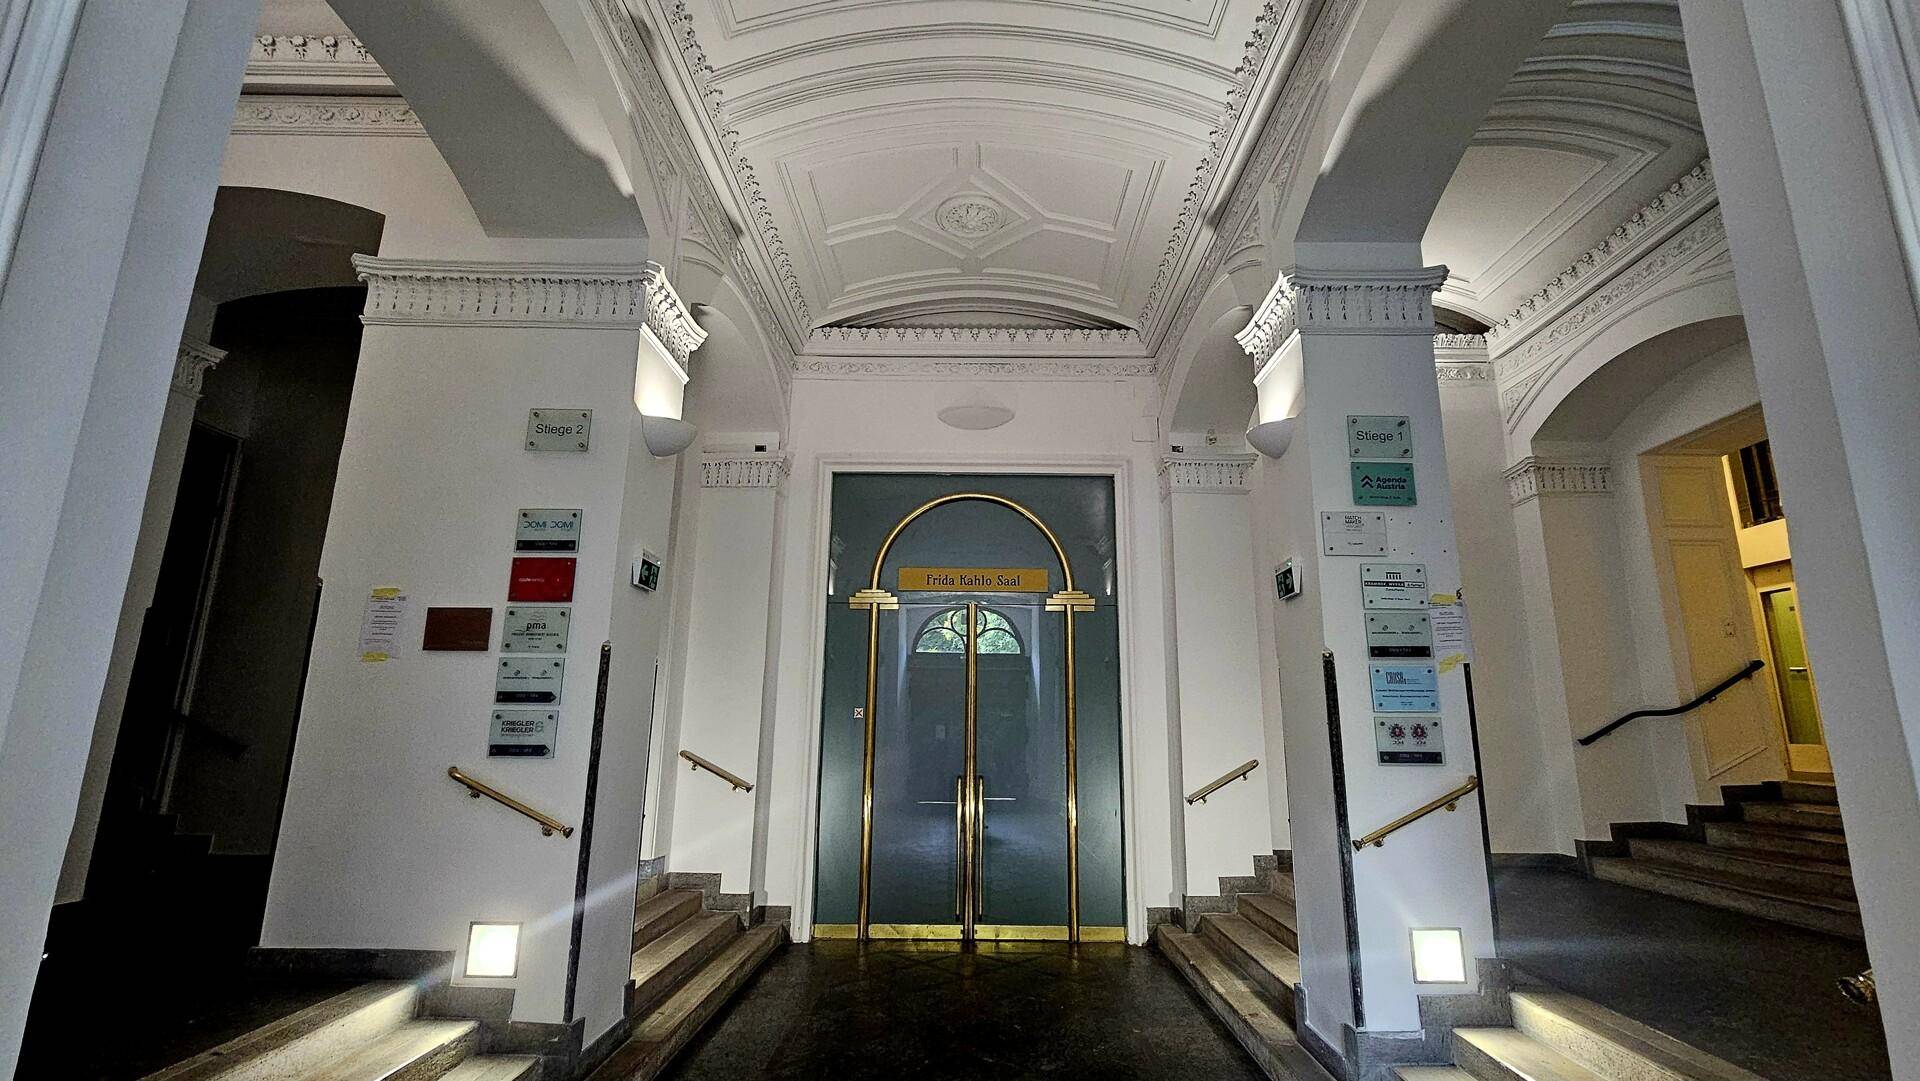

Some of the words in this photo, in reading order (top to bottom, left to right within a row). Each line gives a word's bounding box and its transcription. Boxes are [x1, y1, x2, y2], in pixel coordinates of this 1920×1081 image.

[535, 423, 573, 437] Stiege
[576, 424, 584, 435] 2
[1356, 430, 1394, 443] Stiege
[1398, 432, 1403, 441] 1
[1375, 476, 1407, 484] Agenda
[926, 574, 955, 586] Frida
[960, 574, 992, 586] Kahlo
[997, 575, 1020, 587] Saal
[526, 622, 547, 632] pma
